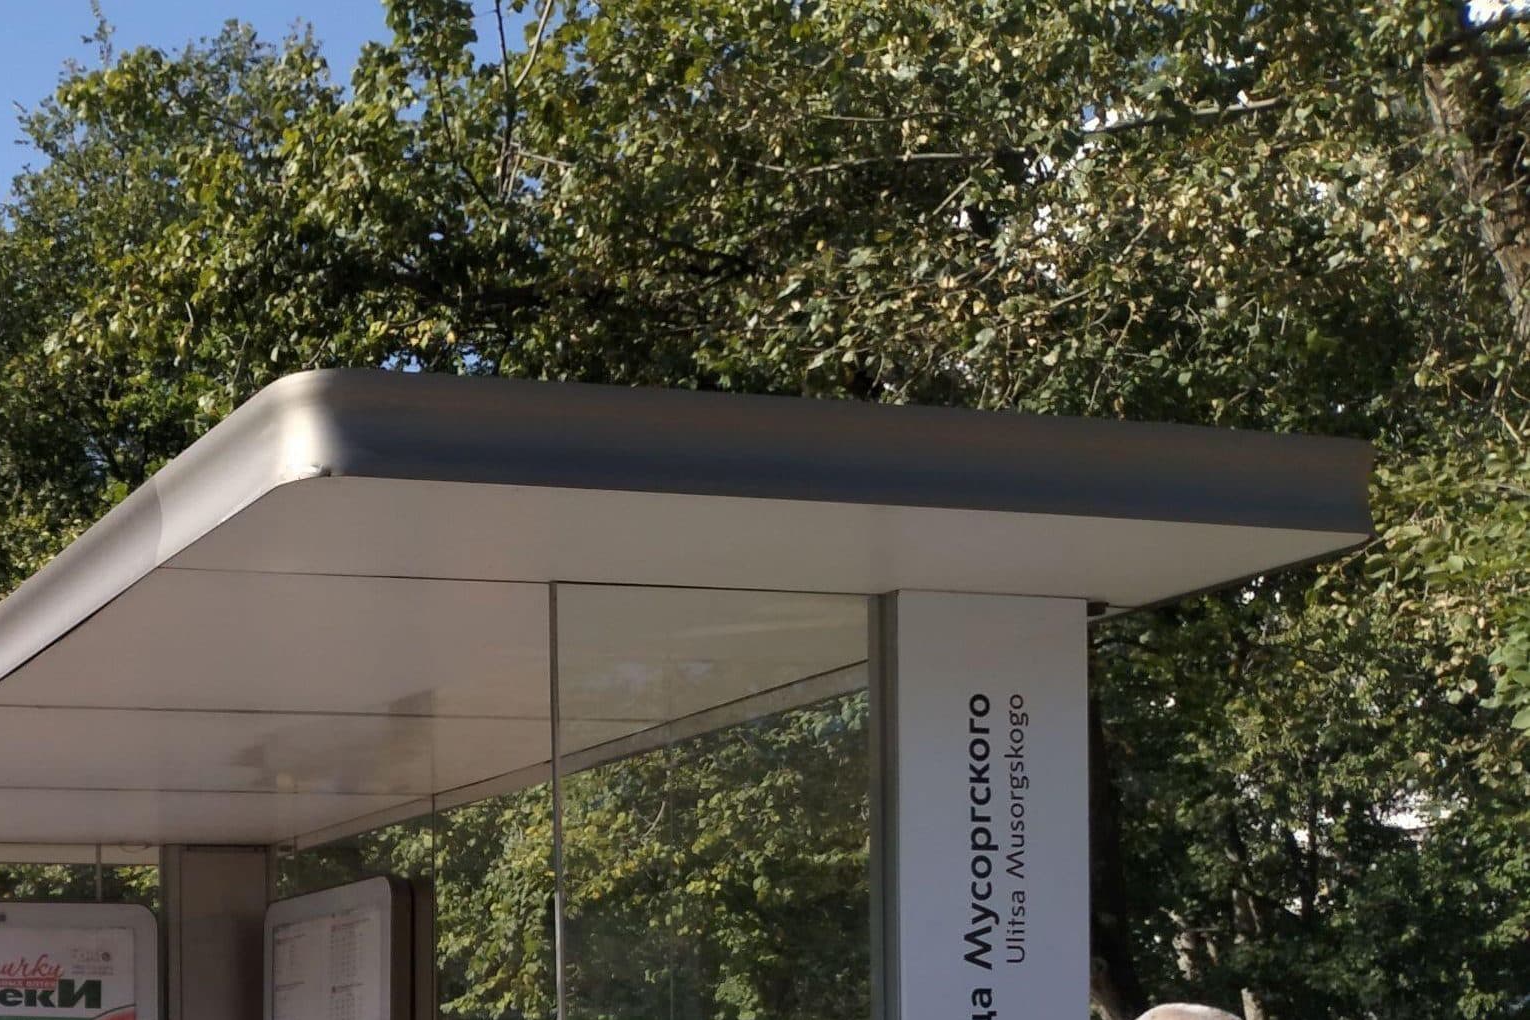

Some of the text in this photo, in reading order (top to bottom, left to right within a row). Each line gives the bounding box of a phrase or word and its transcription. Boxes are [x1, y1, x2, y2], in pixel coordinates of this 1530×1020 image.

[963, 693, 999, 970] Мусоргского
[1003, 694, 1029, 964] Ulitsa Musorgskogo
